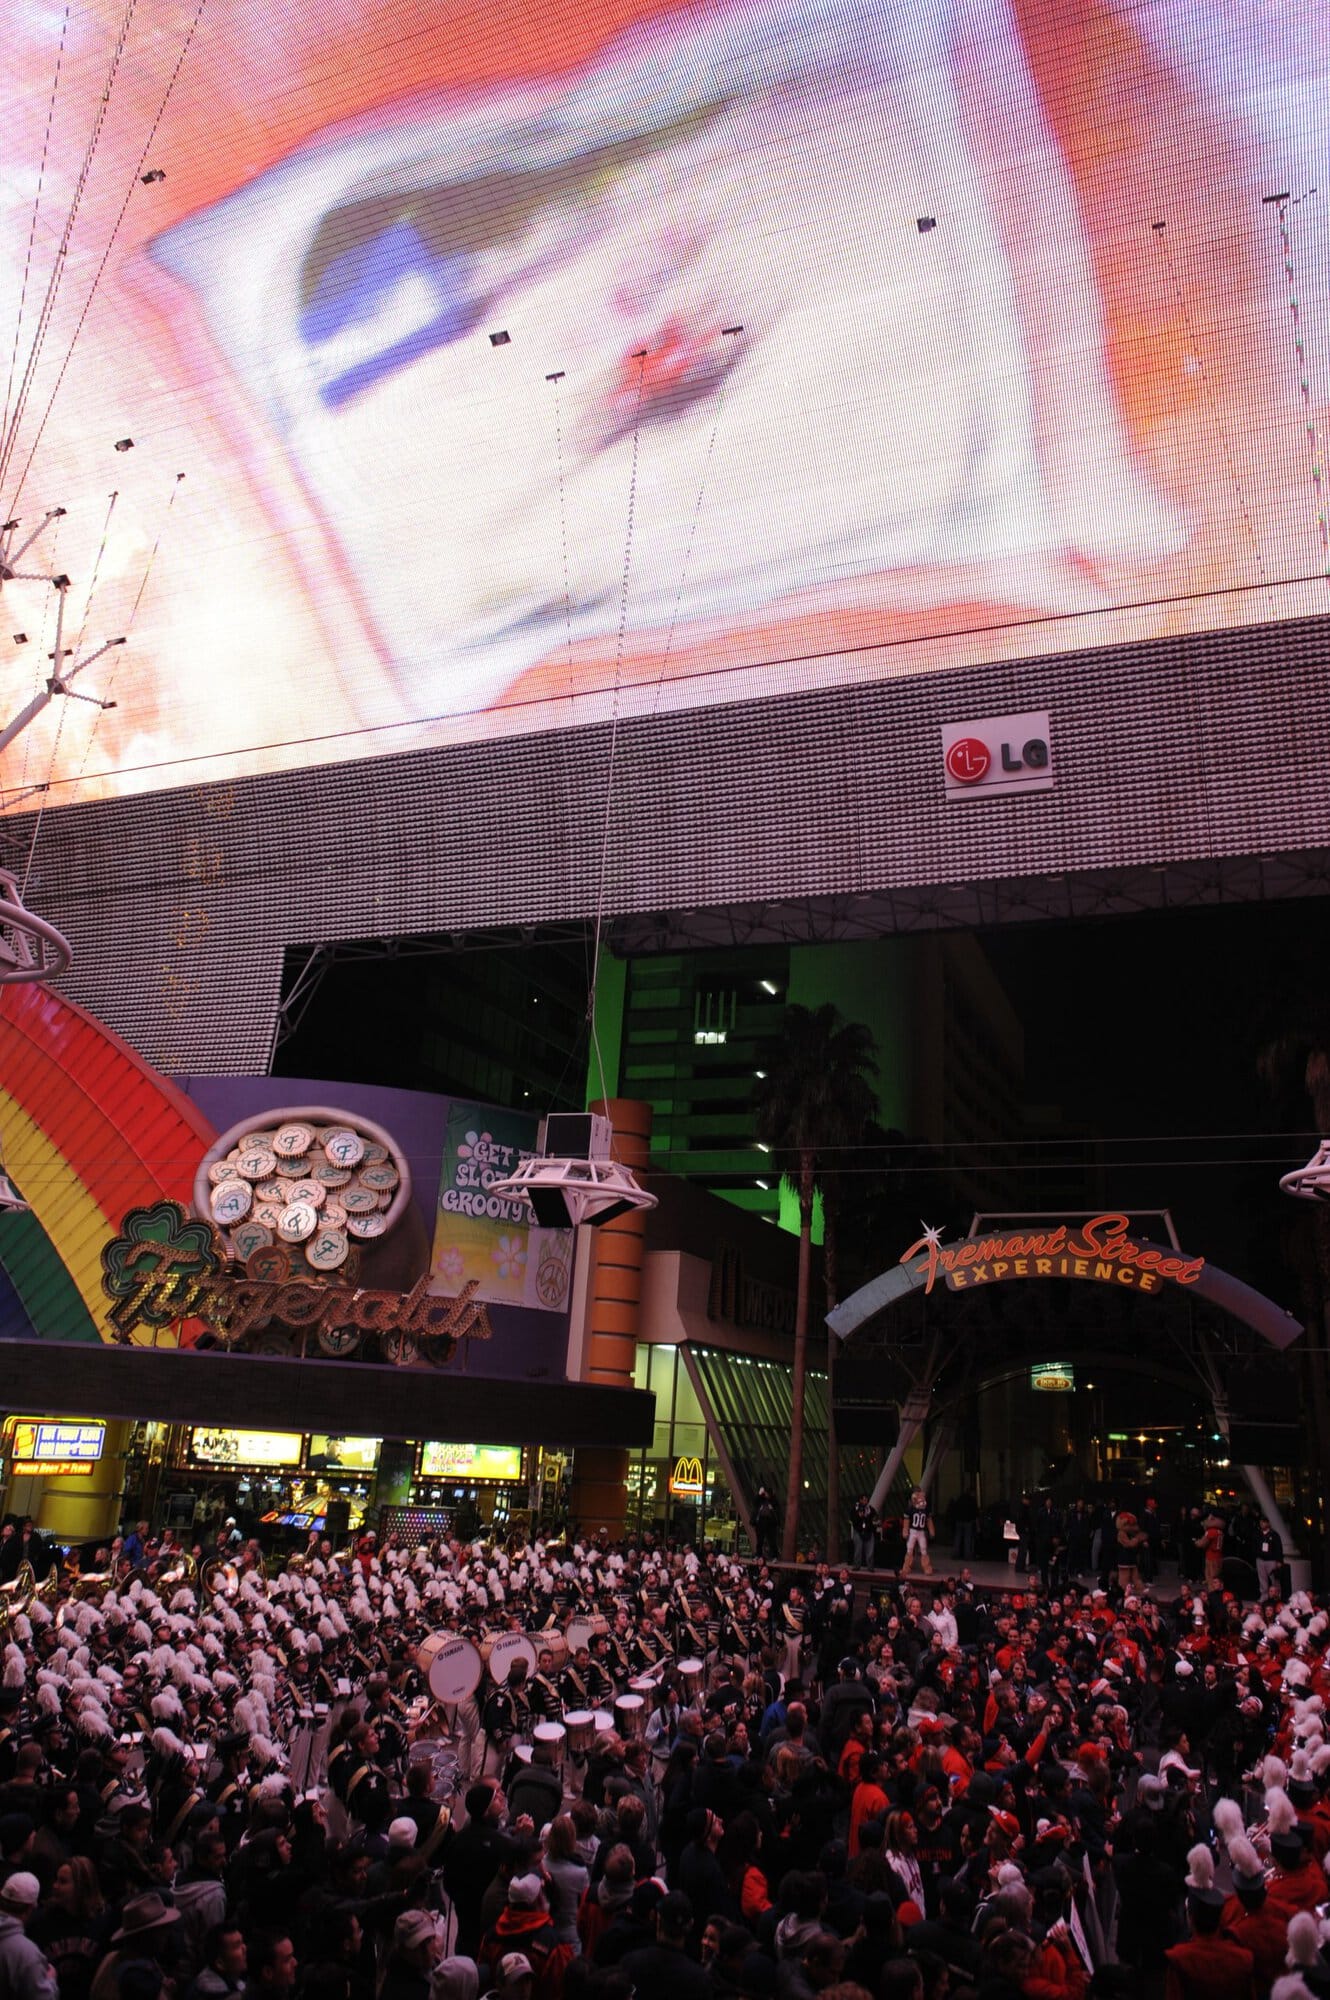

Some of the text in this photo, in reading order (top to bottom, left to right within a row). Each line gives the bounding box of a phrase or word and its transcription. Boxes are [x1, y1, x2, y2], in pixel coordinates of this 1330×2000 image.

[1001, 739, 1048, 771] LG
[337, 1145, 352, 1163] F
[473, 1140, 514, 1167] GET
[442, 1189, 522, 1223] GROOVY
[900, 1214, 1205, 1294] Fremont Street
[953, 1258, 1157, 1291] EXPERIENCE
[912, 1513, 926, 1528] 00
